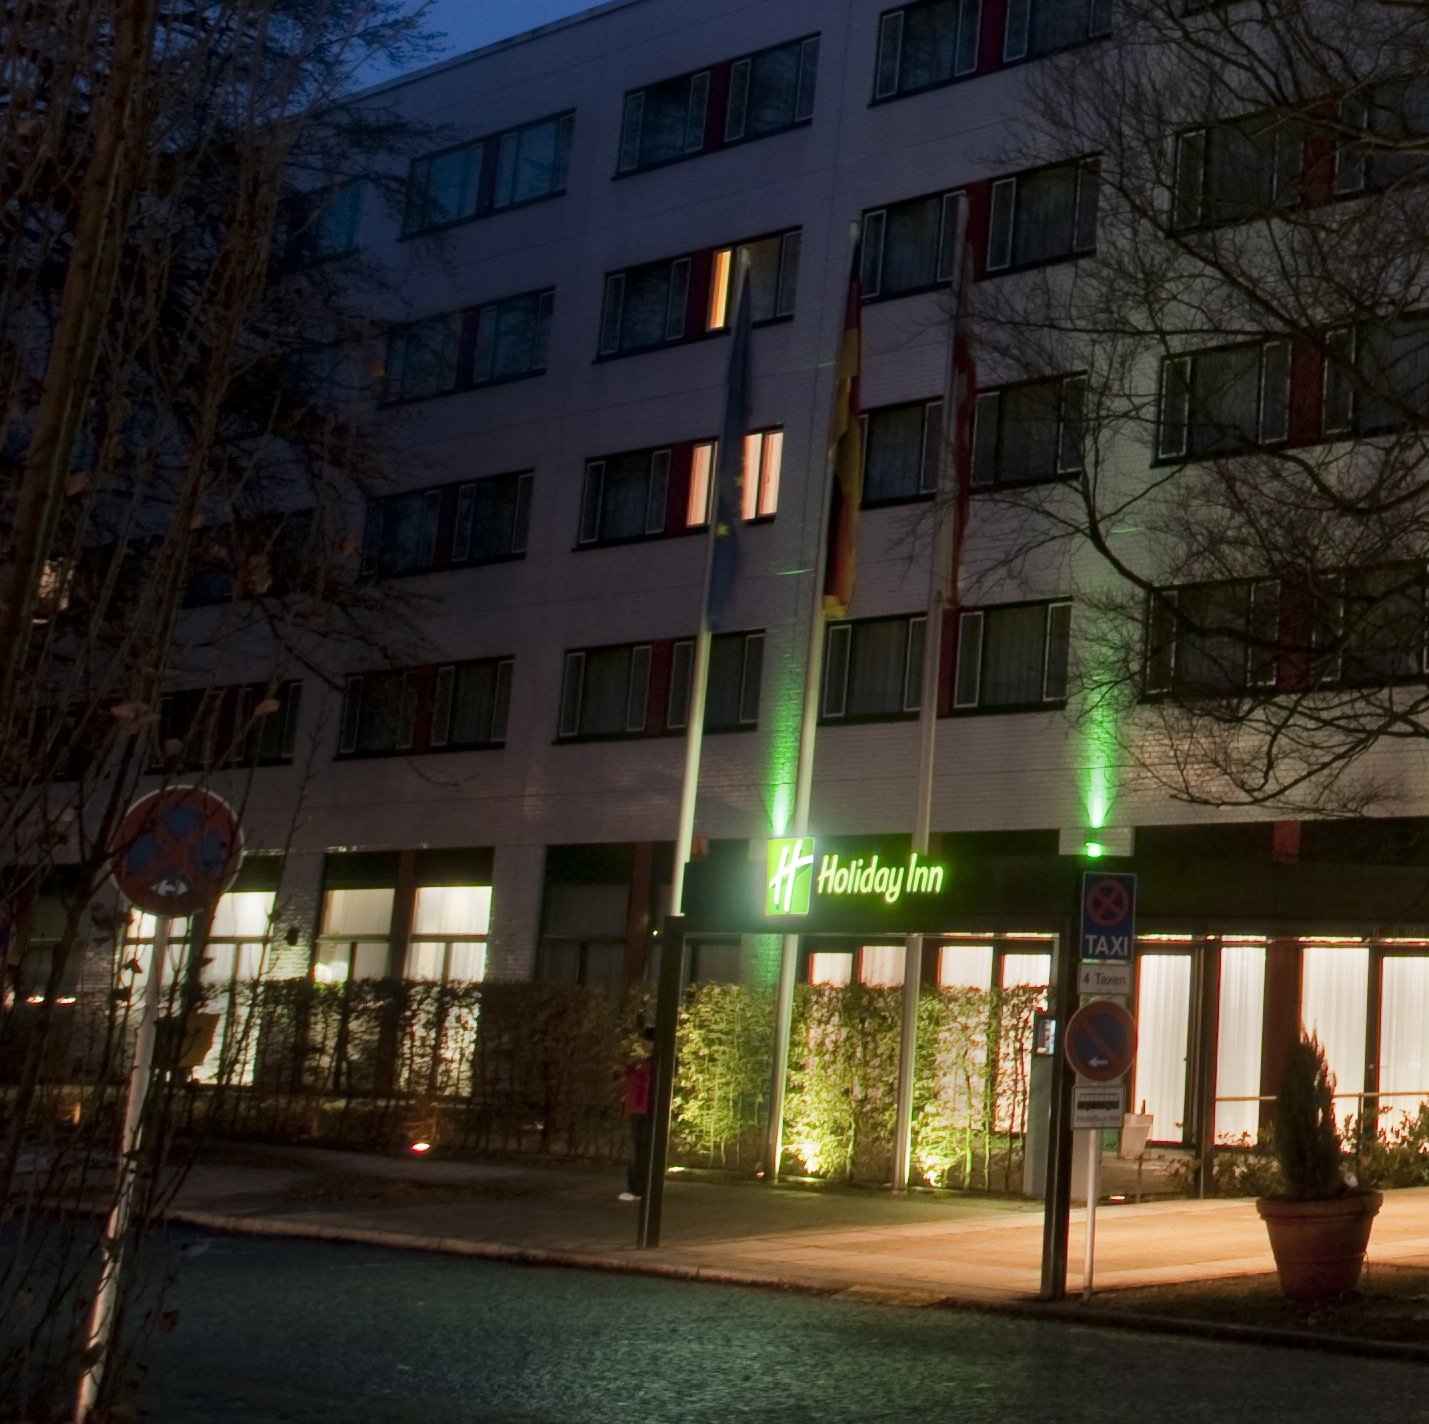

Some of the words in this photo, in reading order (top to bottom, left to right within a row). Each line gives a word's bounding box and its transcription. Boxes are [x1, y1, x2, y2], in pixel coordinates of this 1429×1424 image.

[817, 853, 905, 904] Holiday
[905, 852, 944, 893] Inn
[1084, 934, 1129, 956] TAXI
[1082, 972, 1090, 984] 4
[1095, 972, 1126, 985] Taxen
